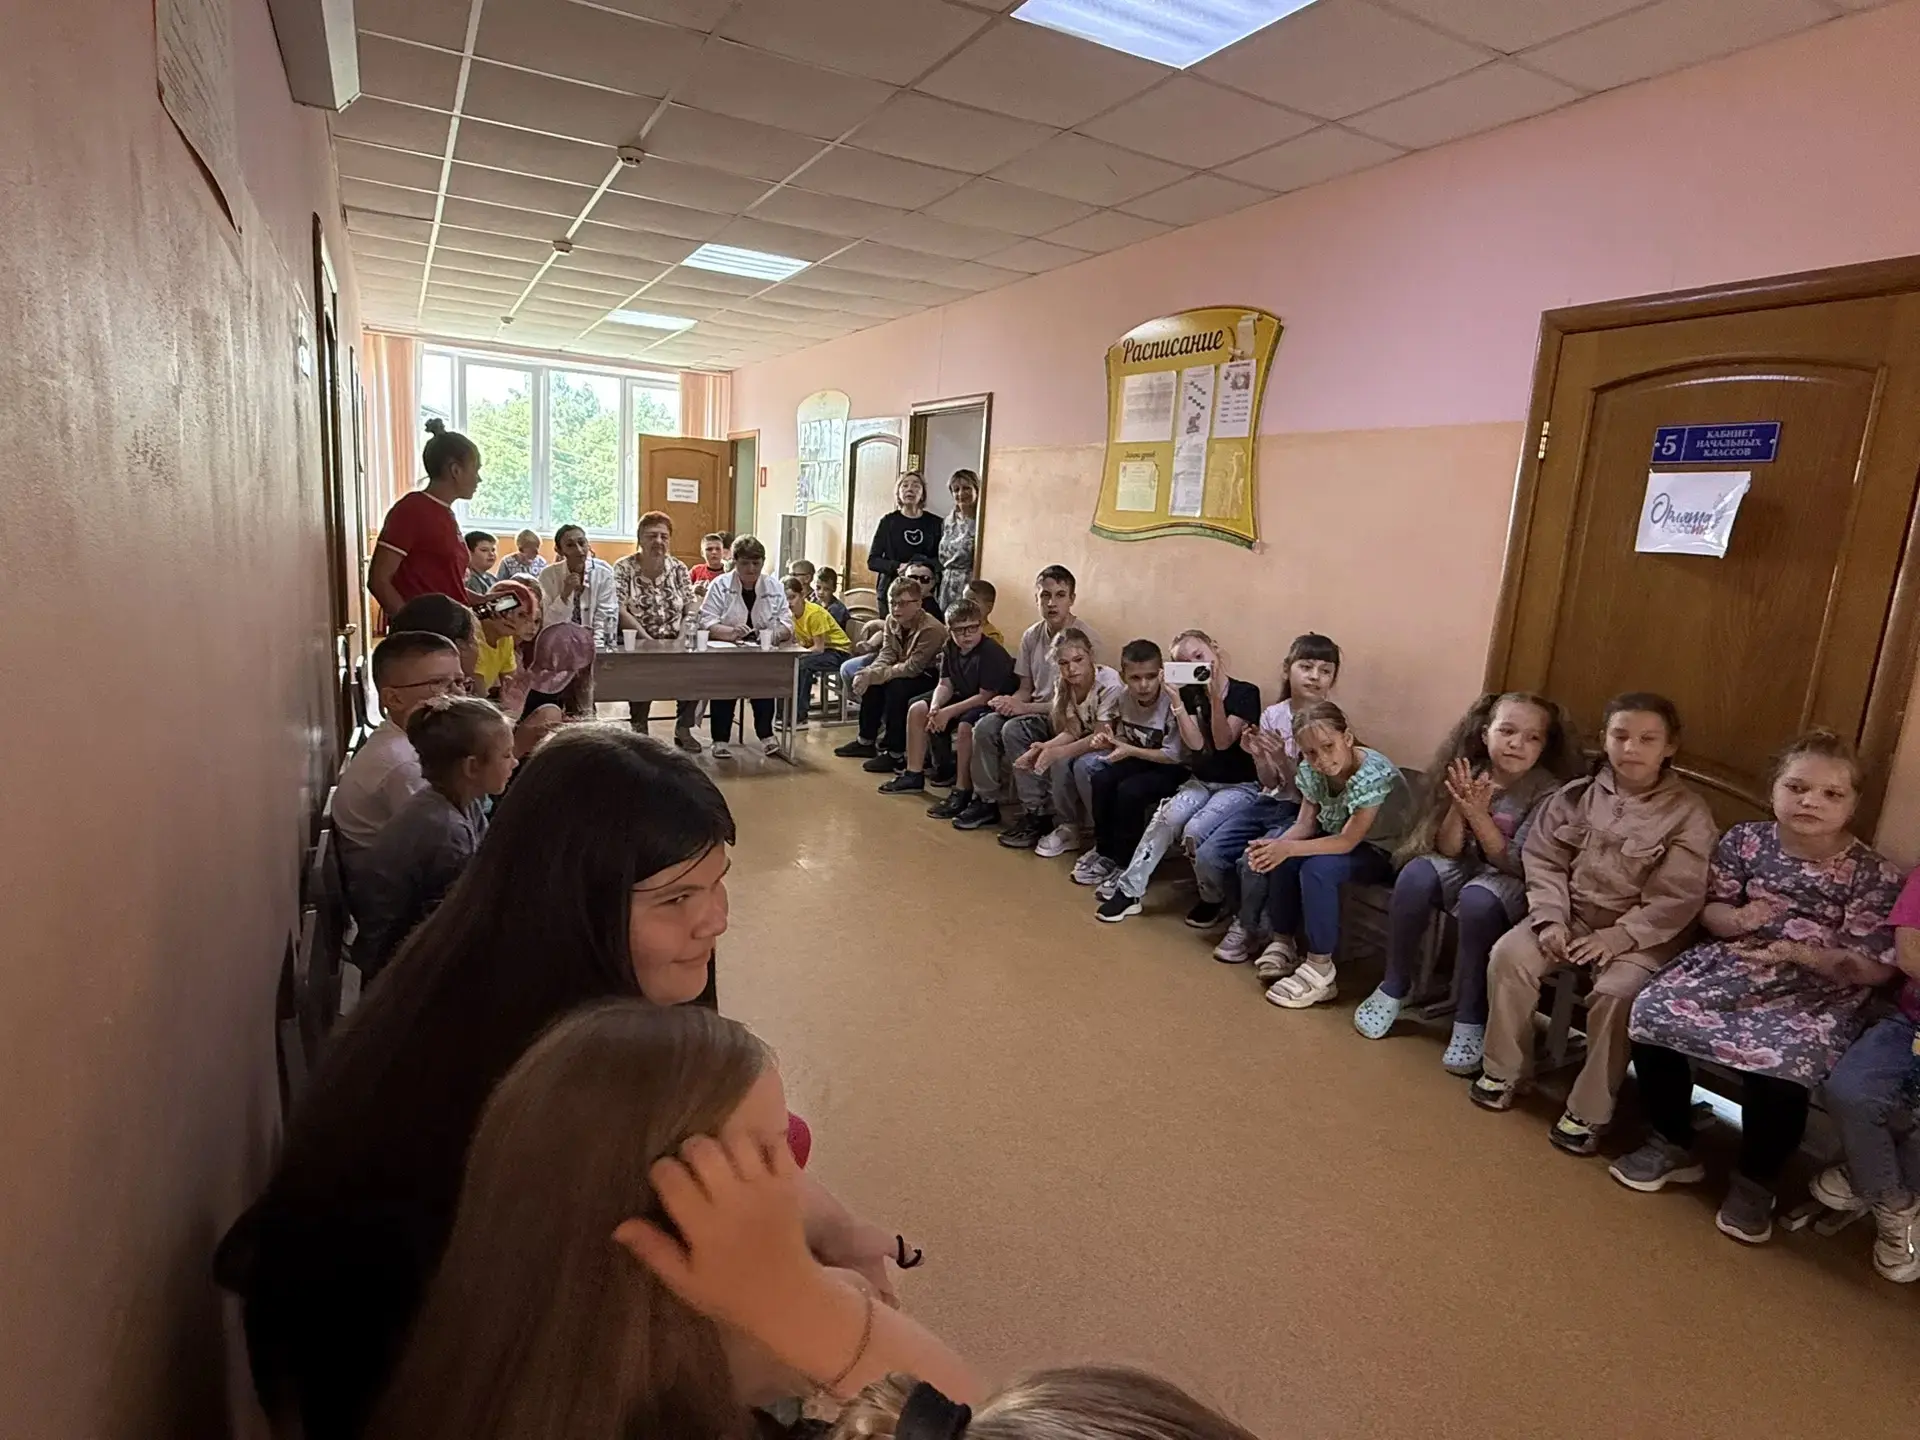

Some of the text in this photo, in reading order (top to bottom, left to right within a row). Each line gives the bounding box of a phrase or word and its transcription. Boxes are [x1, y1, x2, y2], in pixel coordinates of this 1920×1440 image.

[1123, 329, 1225, 364] Расписание
[1706, 429, 1756, 438] КАБИНЕТ
[1661, 434, 1678, 456] 5
[1695, 438, 1762, 448] НАЧАЛЬНЫХ
[1703, 447, 1752, 457] КЛАССОВ
